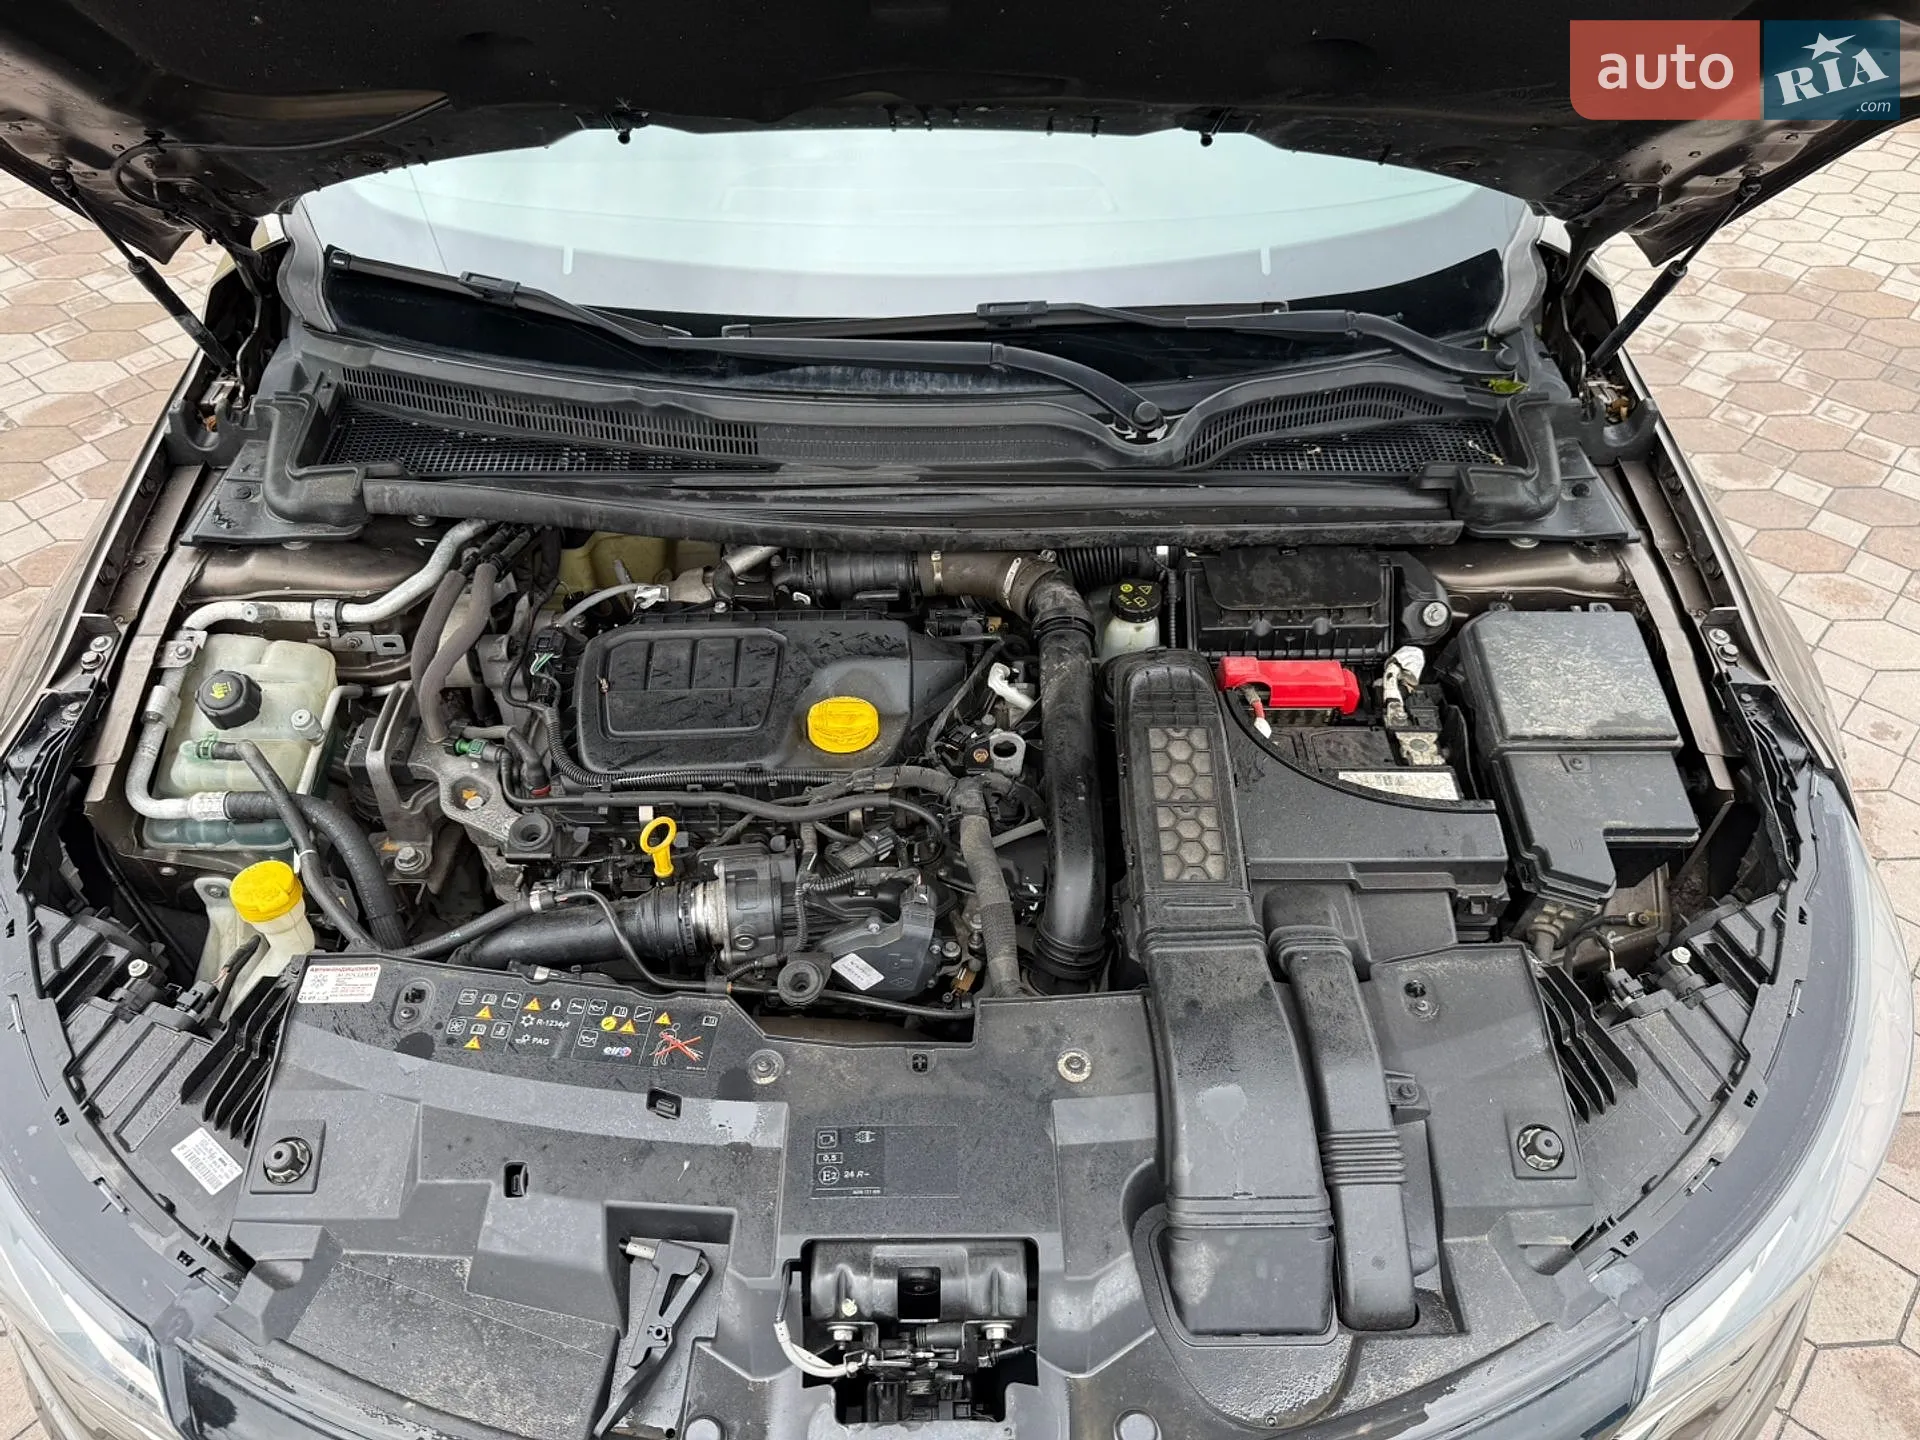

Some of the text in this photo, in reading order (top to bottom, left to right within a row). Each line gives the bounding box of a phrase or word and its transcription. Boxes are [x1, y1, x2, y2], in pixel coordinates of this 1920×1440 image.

[536, 1018, 570, 1029] R-1234yf
[532, 1037, 550, 1045] PAG
[603, 1046, 623, 1056] elf
